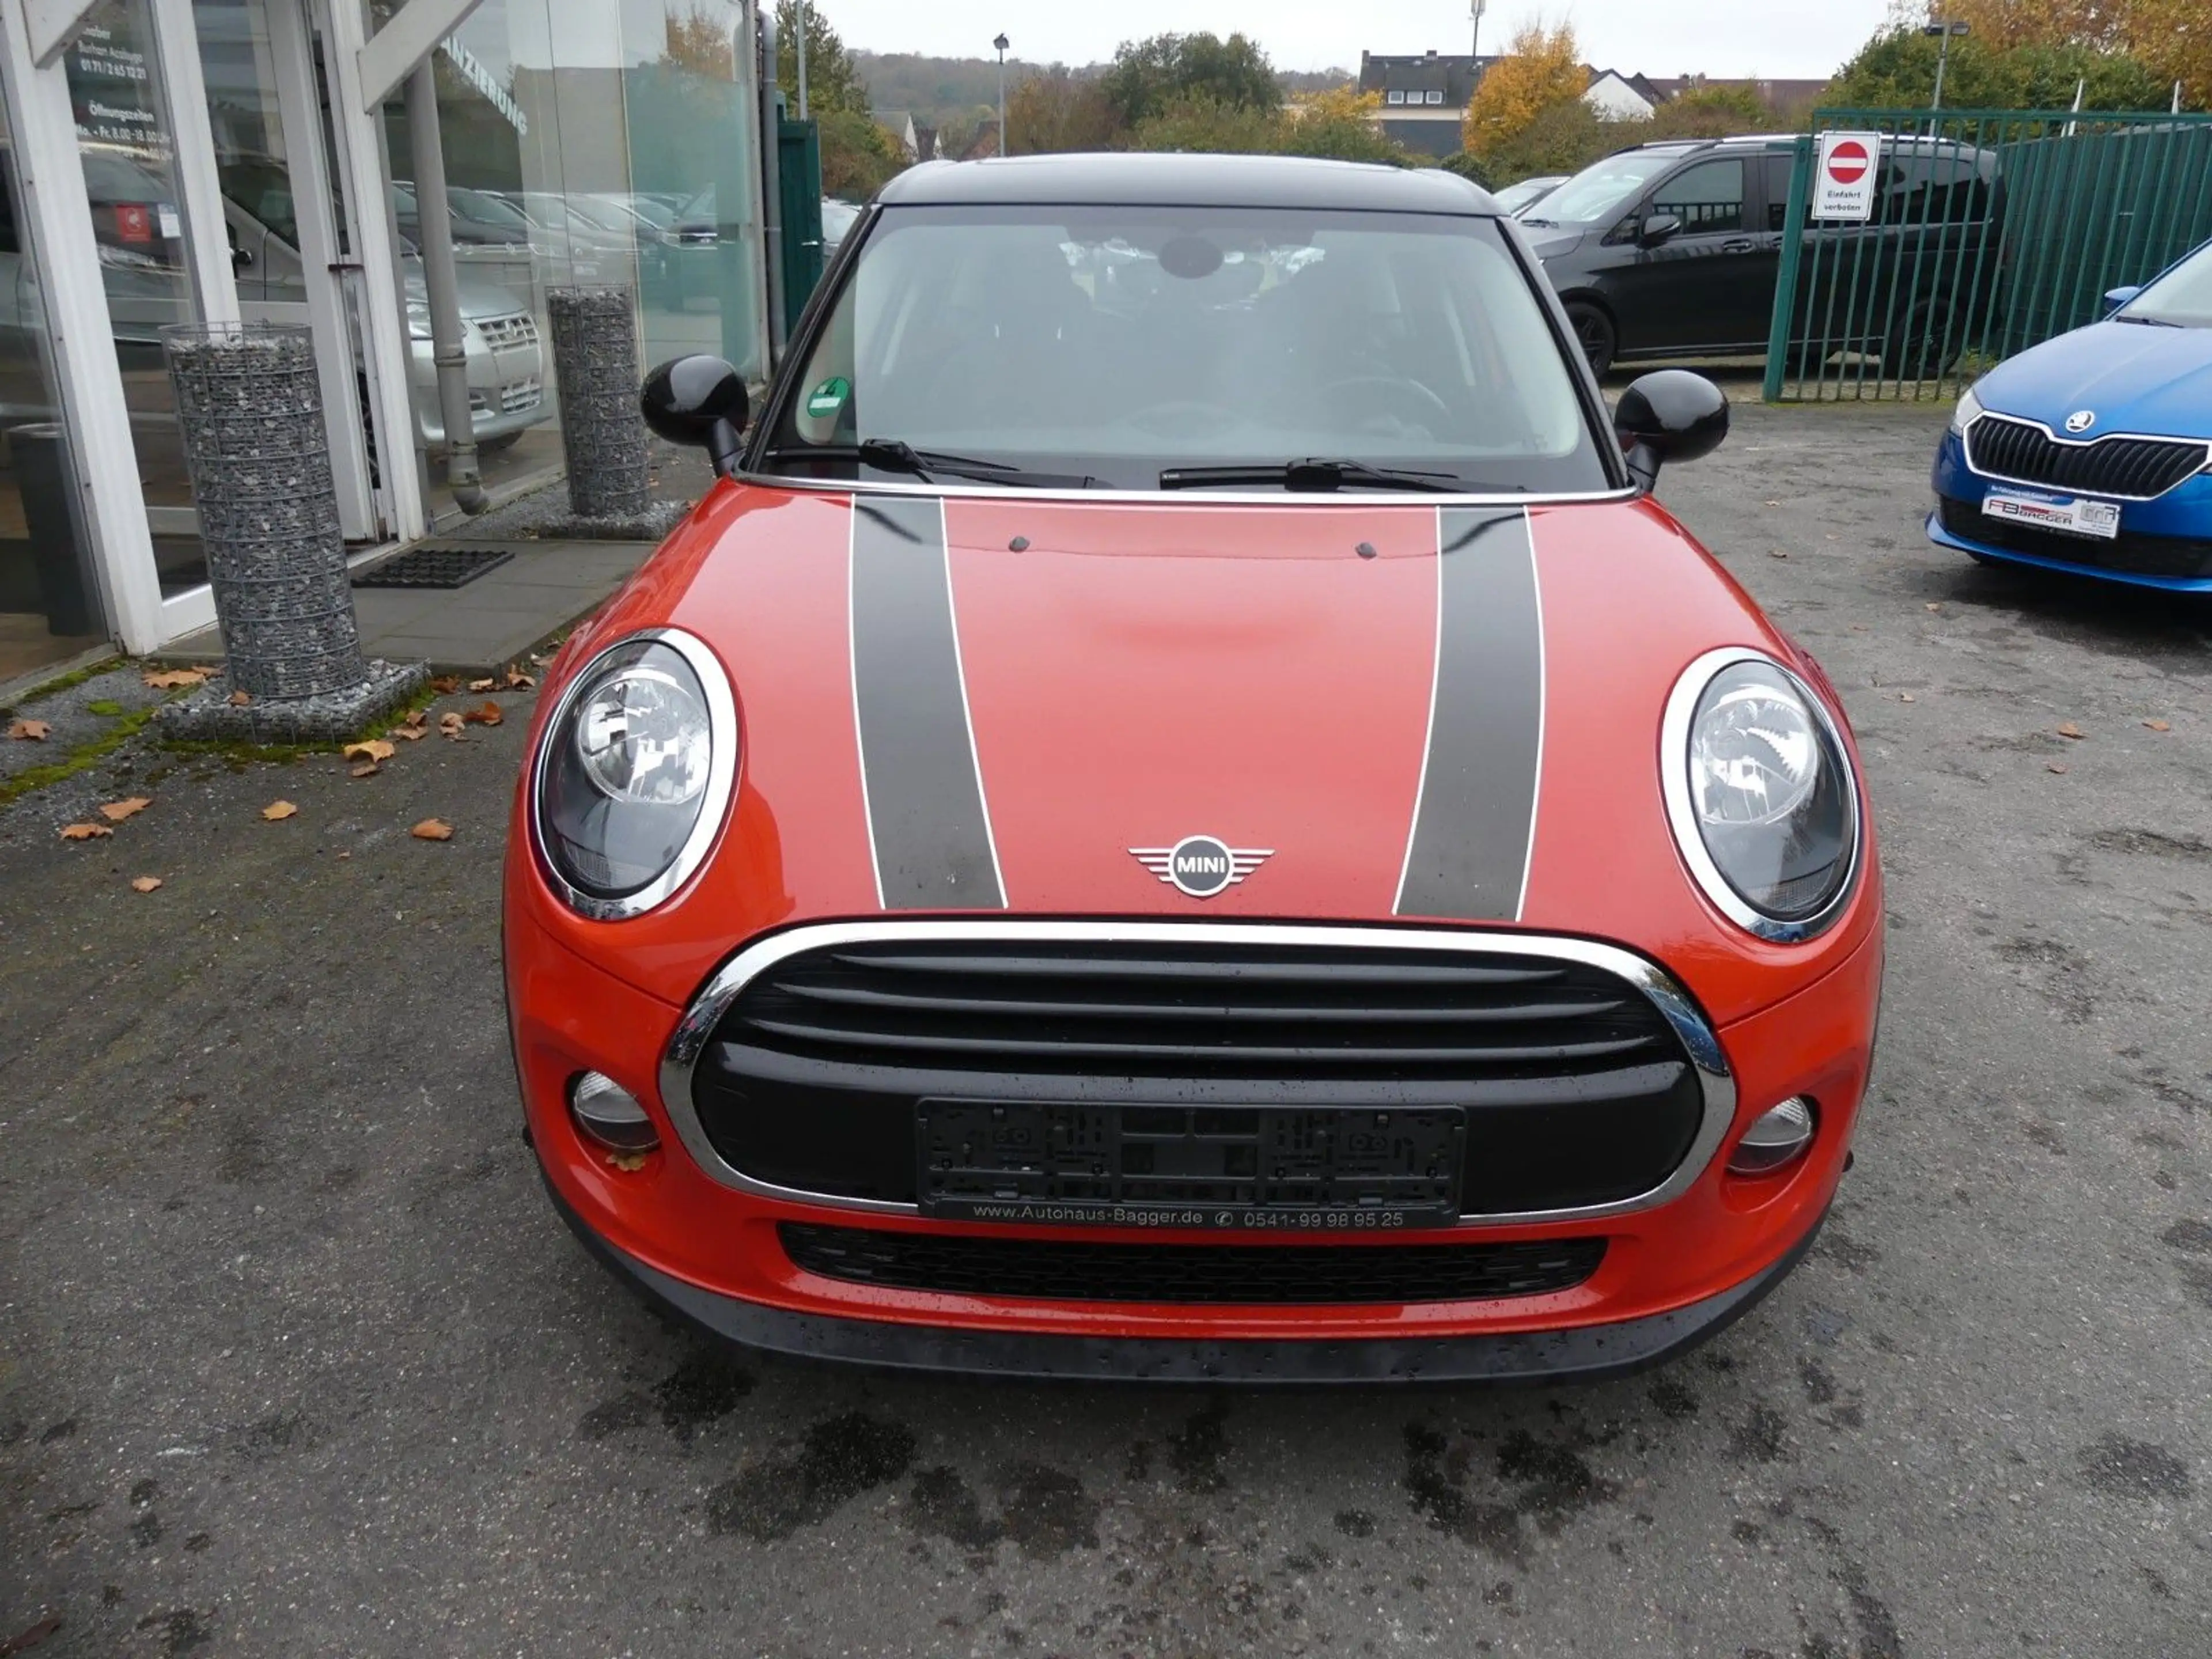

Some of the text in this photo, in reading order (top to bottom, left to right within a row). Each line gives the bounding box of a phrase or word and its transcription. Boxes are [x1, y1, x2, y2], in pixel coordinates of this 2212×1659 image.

[1827, 190, 1861, 198] Einfahrt
[1824, 203, 1861, 211] verboten
[824, 377, 839, 397] 4
[1177, 857, 1226, 873] MINI
[973, 1205, 1203, 1226] www.Autohaus-Bagger.de
[1327, 1212, 1350, 1227] 98
[1354, 1212, 1376, 1227] 95
[1382, 1211, 1404, 1226] 25
